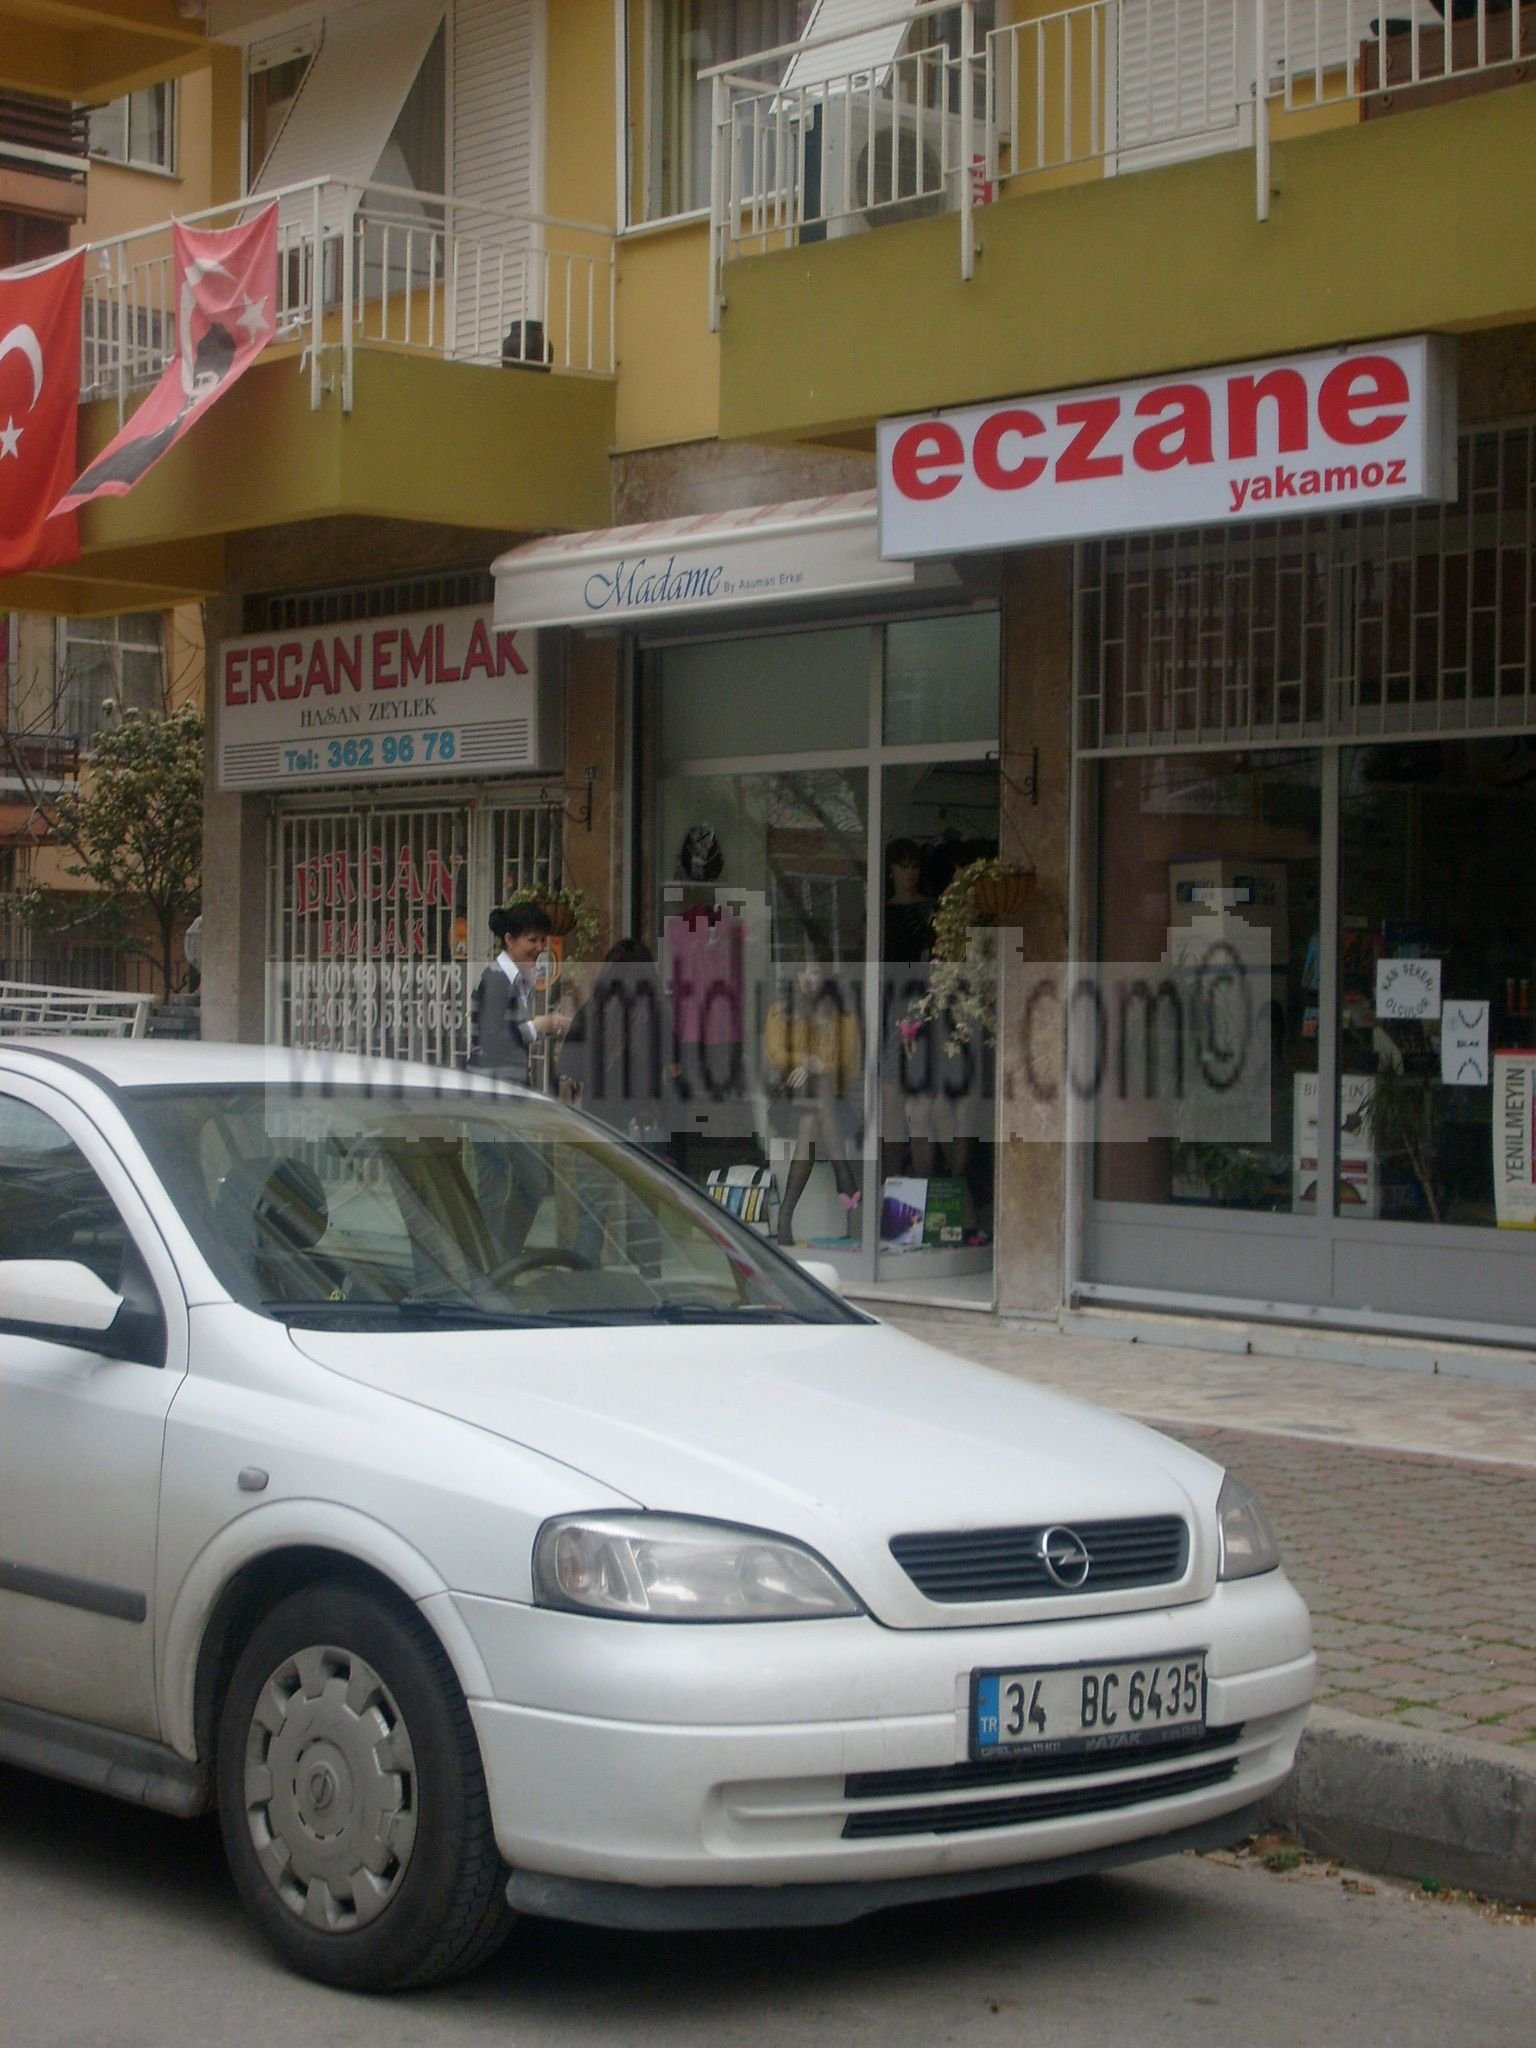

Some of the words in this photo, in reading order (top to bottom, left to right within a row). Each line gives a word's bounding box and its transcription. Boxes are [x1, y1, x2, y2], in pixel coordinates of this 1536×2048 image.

[892, 355, 1410, 501] eczane
[1229, 457, 1407, 512] yakamoz
[584, 555, 723, 610] Madame
[724, 581, 735, 594] By
[225, 634, 362, 706] ERCAN
[372, 619, 529, 690] EMLAK
[300, 705, 360, 728] HASAN
[368, 697, 437, 722] ZEYLEK
[284, 750, 320, 772] Tel:
[327, 738, 374, 769] 362
[382, 735, 415, 764] 96
[422, 731, 456, 760] 78
[294, 845, 462, 916] ERCAN
[416, 964, 436, 994] 96
[981, 1717, 998, 1732] TR
[1006, 1679, 1047, 1735] 34
[1080, 1673, 1119, 1728] BC
[1128, 1664, 1199, 1722] 6435
